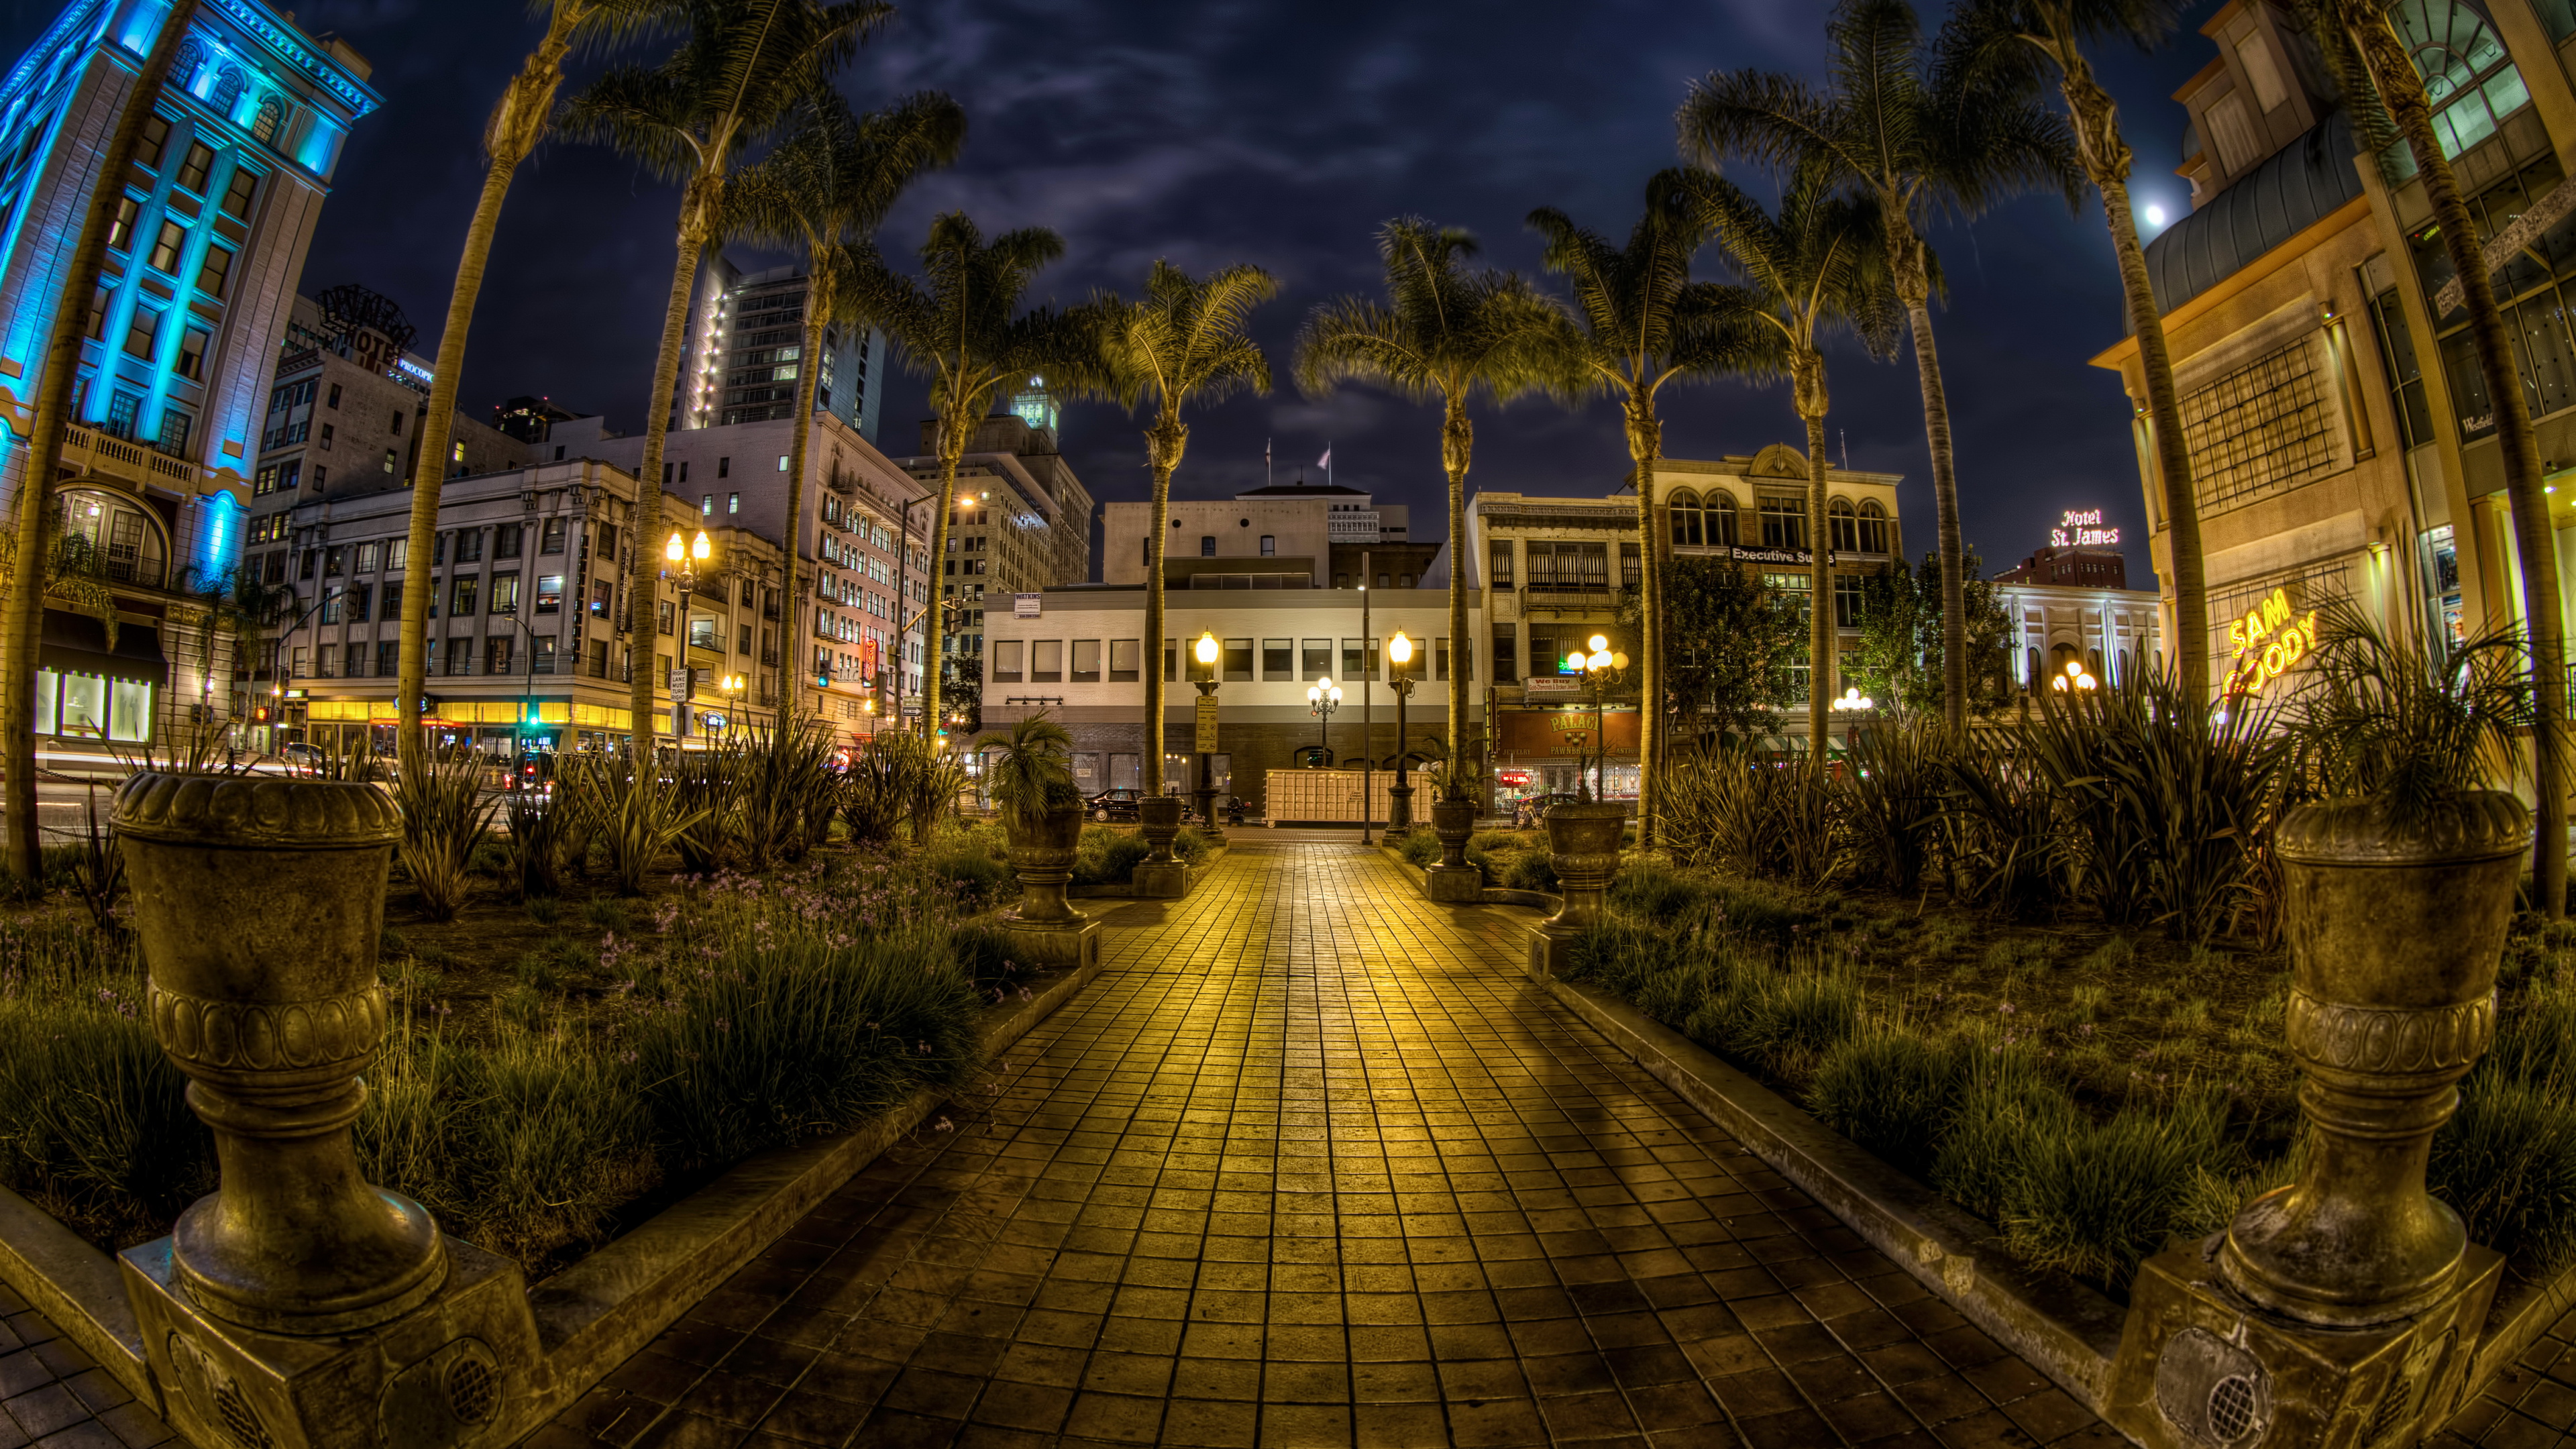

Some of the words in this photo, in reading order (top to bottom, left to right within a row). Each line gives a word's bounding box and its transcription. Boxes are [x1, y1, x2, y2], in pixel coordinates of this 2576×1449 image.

[2461, 413, 2493, 434] Westfield
[2061, 508, 2102, 527] Hotel
[2072, 527, 2119, 545] James
[1732, 547, 1794, 562] Executive
[1796, 551, 1835, 564] Sus
[2229, 588, 2291, 659] SAM
